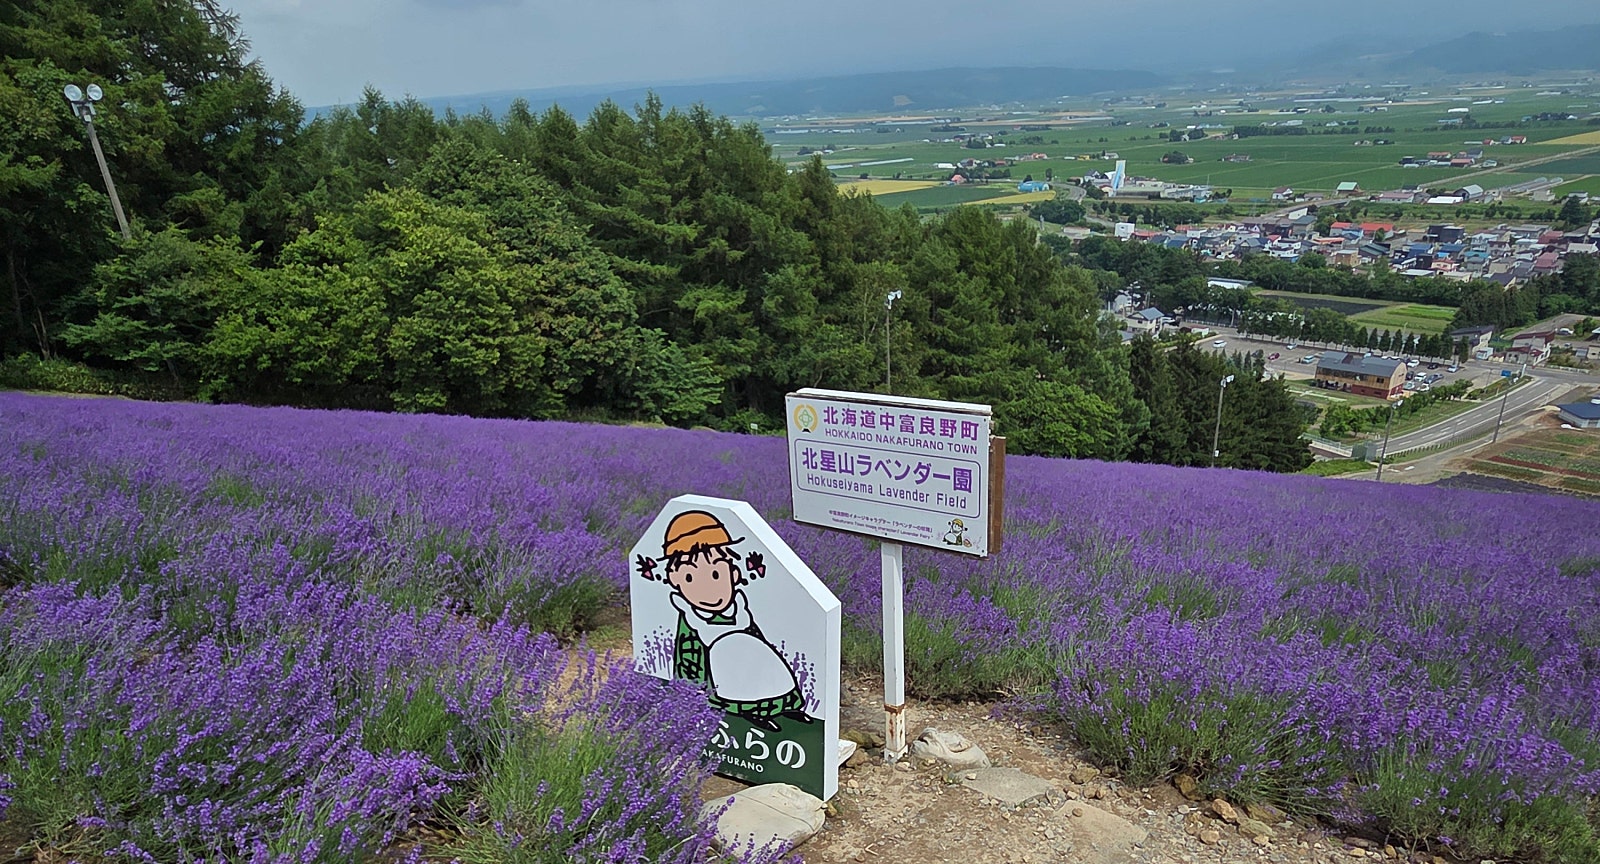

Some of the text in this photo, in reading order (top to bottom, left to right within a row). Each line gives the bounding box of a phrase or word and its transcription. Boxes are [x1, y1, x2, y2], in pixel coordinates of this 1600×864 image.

[823, 406, 979, 441] 北海道中富良野町
[825, 428, 977, 455] HOKKAIDO NAKAFURANO TOWN
[802, 448, 972, 493] 北星山ラベンダー園
[807, 473, 967, 509] Hokuseiyama Lavender Field
[702, 748, 764, 773] AKAFURANO
